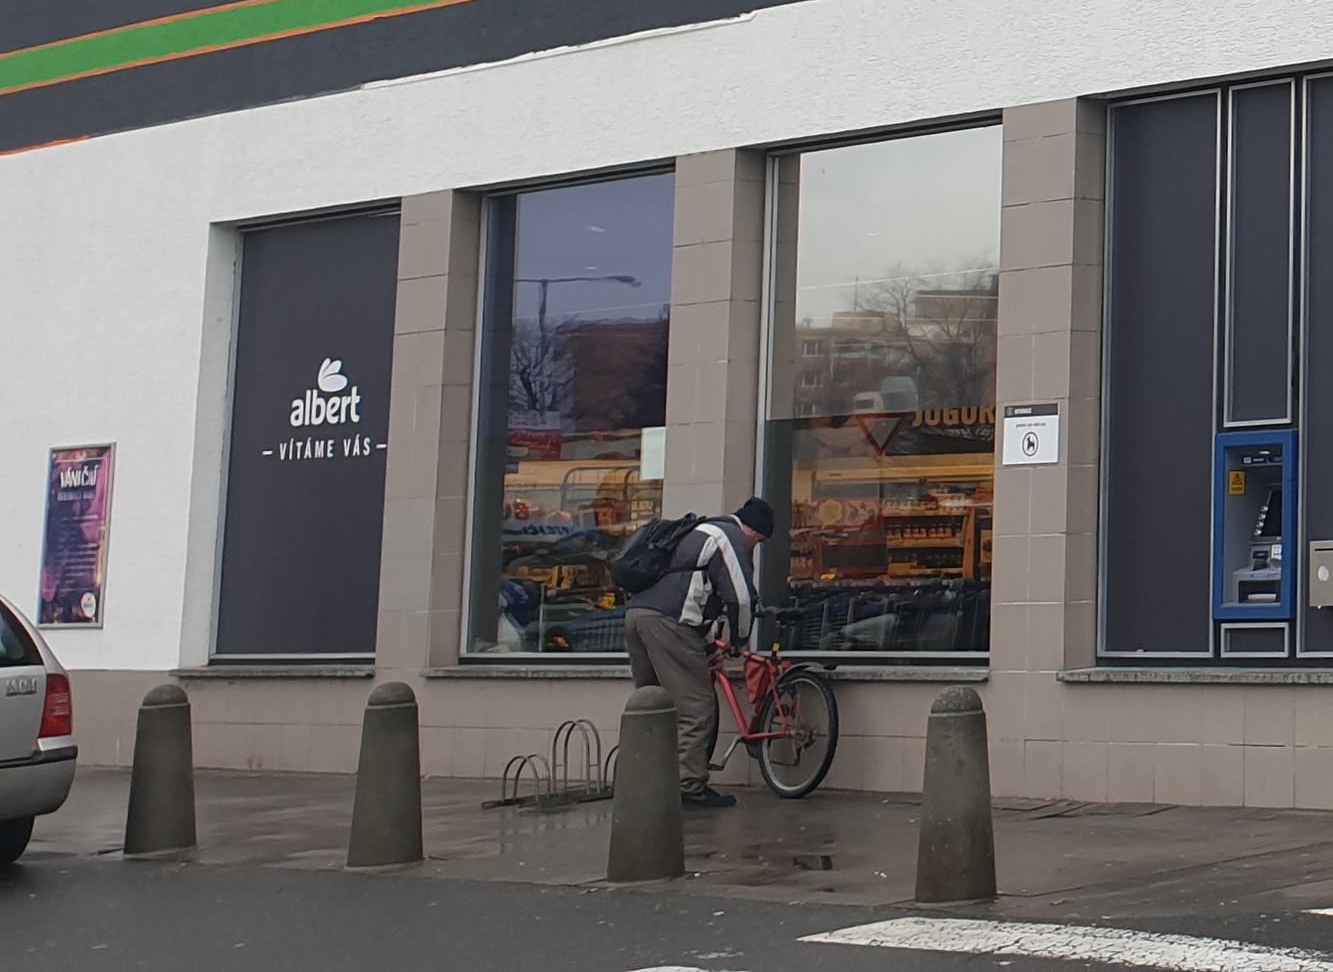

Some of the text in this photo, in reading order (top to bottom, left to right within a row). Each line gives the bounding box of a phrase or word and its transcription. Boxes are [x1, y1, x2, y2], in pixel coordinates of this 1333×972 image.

[290, 386, 361, 426] albert
[912, 405, 995, 427] JOGUR
[279, 433, 371, 460] VÍTÁME VÁS
